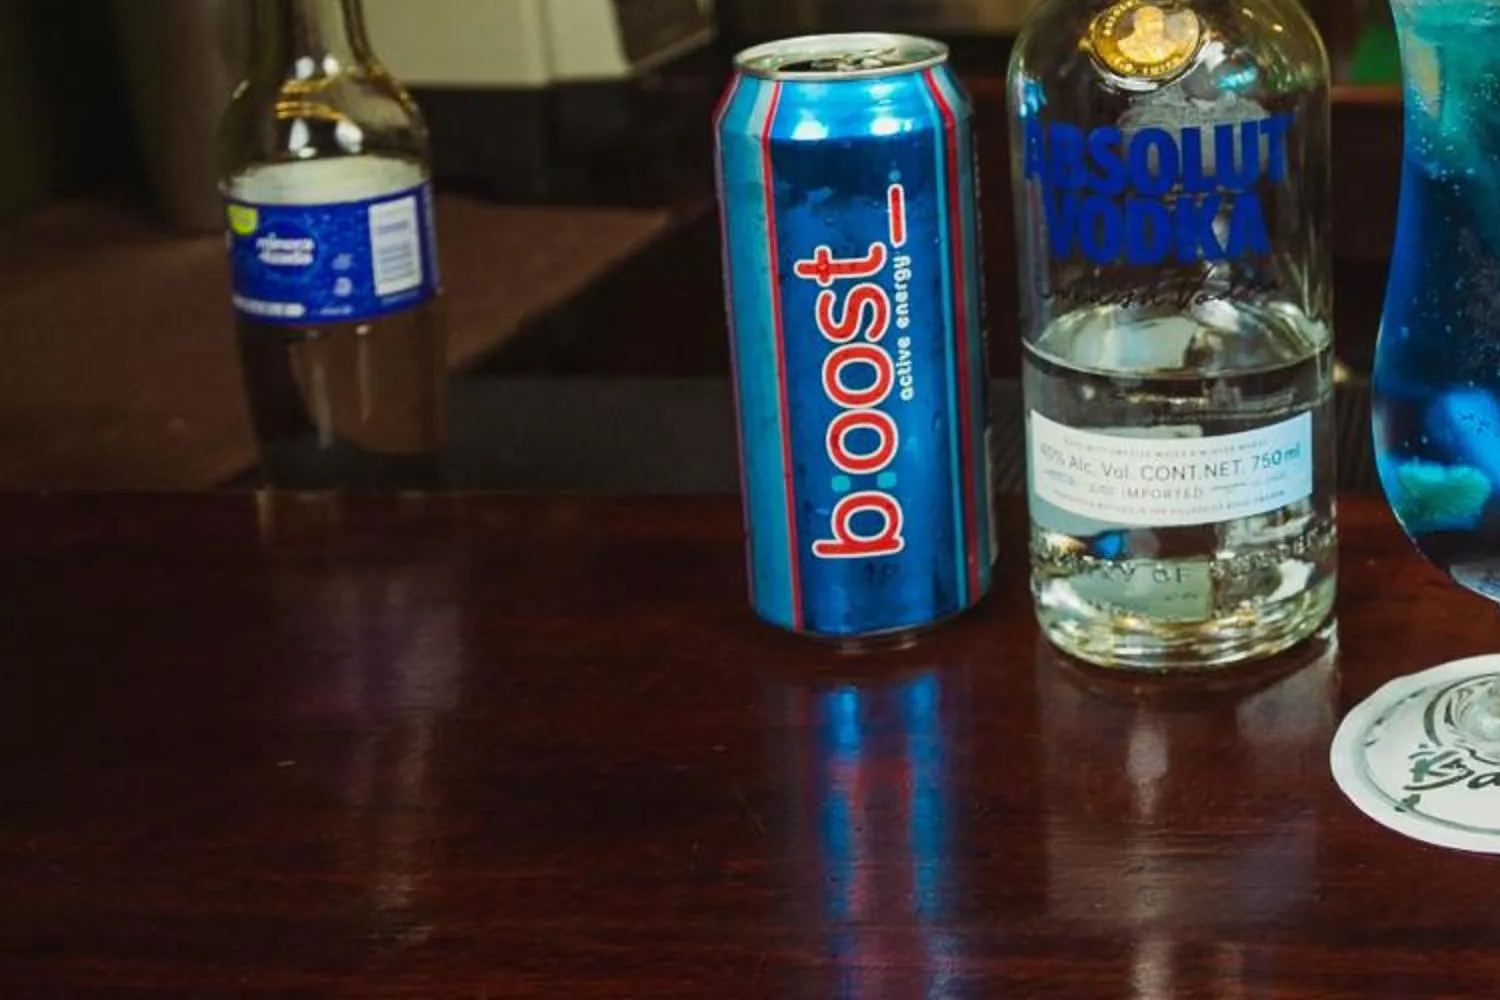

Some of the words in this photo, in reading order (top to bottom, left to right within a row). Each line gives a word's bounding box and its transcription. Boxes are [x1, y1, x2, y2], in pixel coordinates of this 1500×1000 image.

[1024, 112, 1293, 196] ABSOLUT
[1043, 193, 1271, 266] VODKA
[893, 255, 911, 329] energy
[896, 336, 913, 401] active
